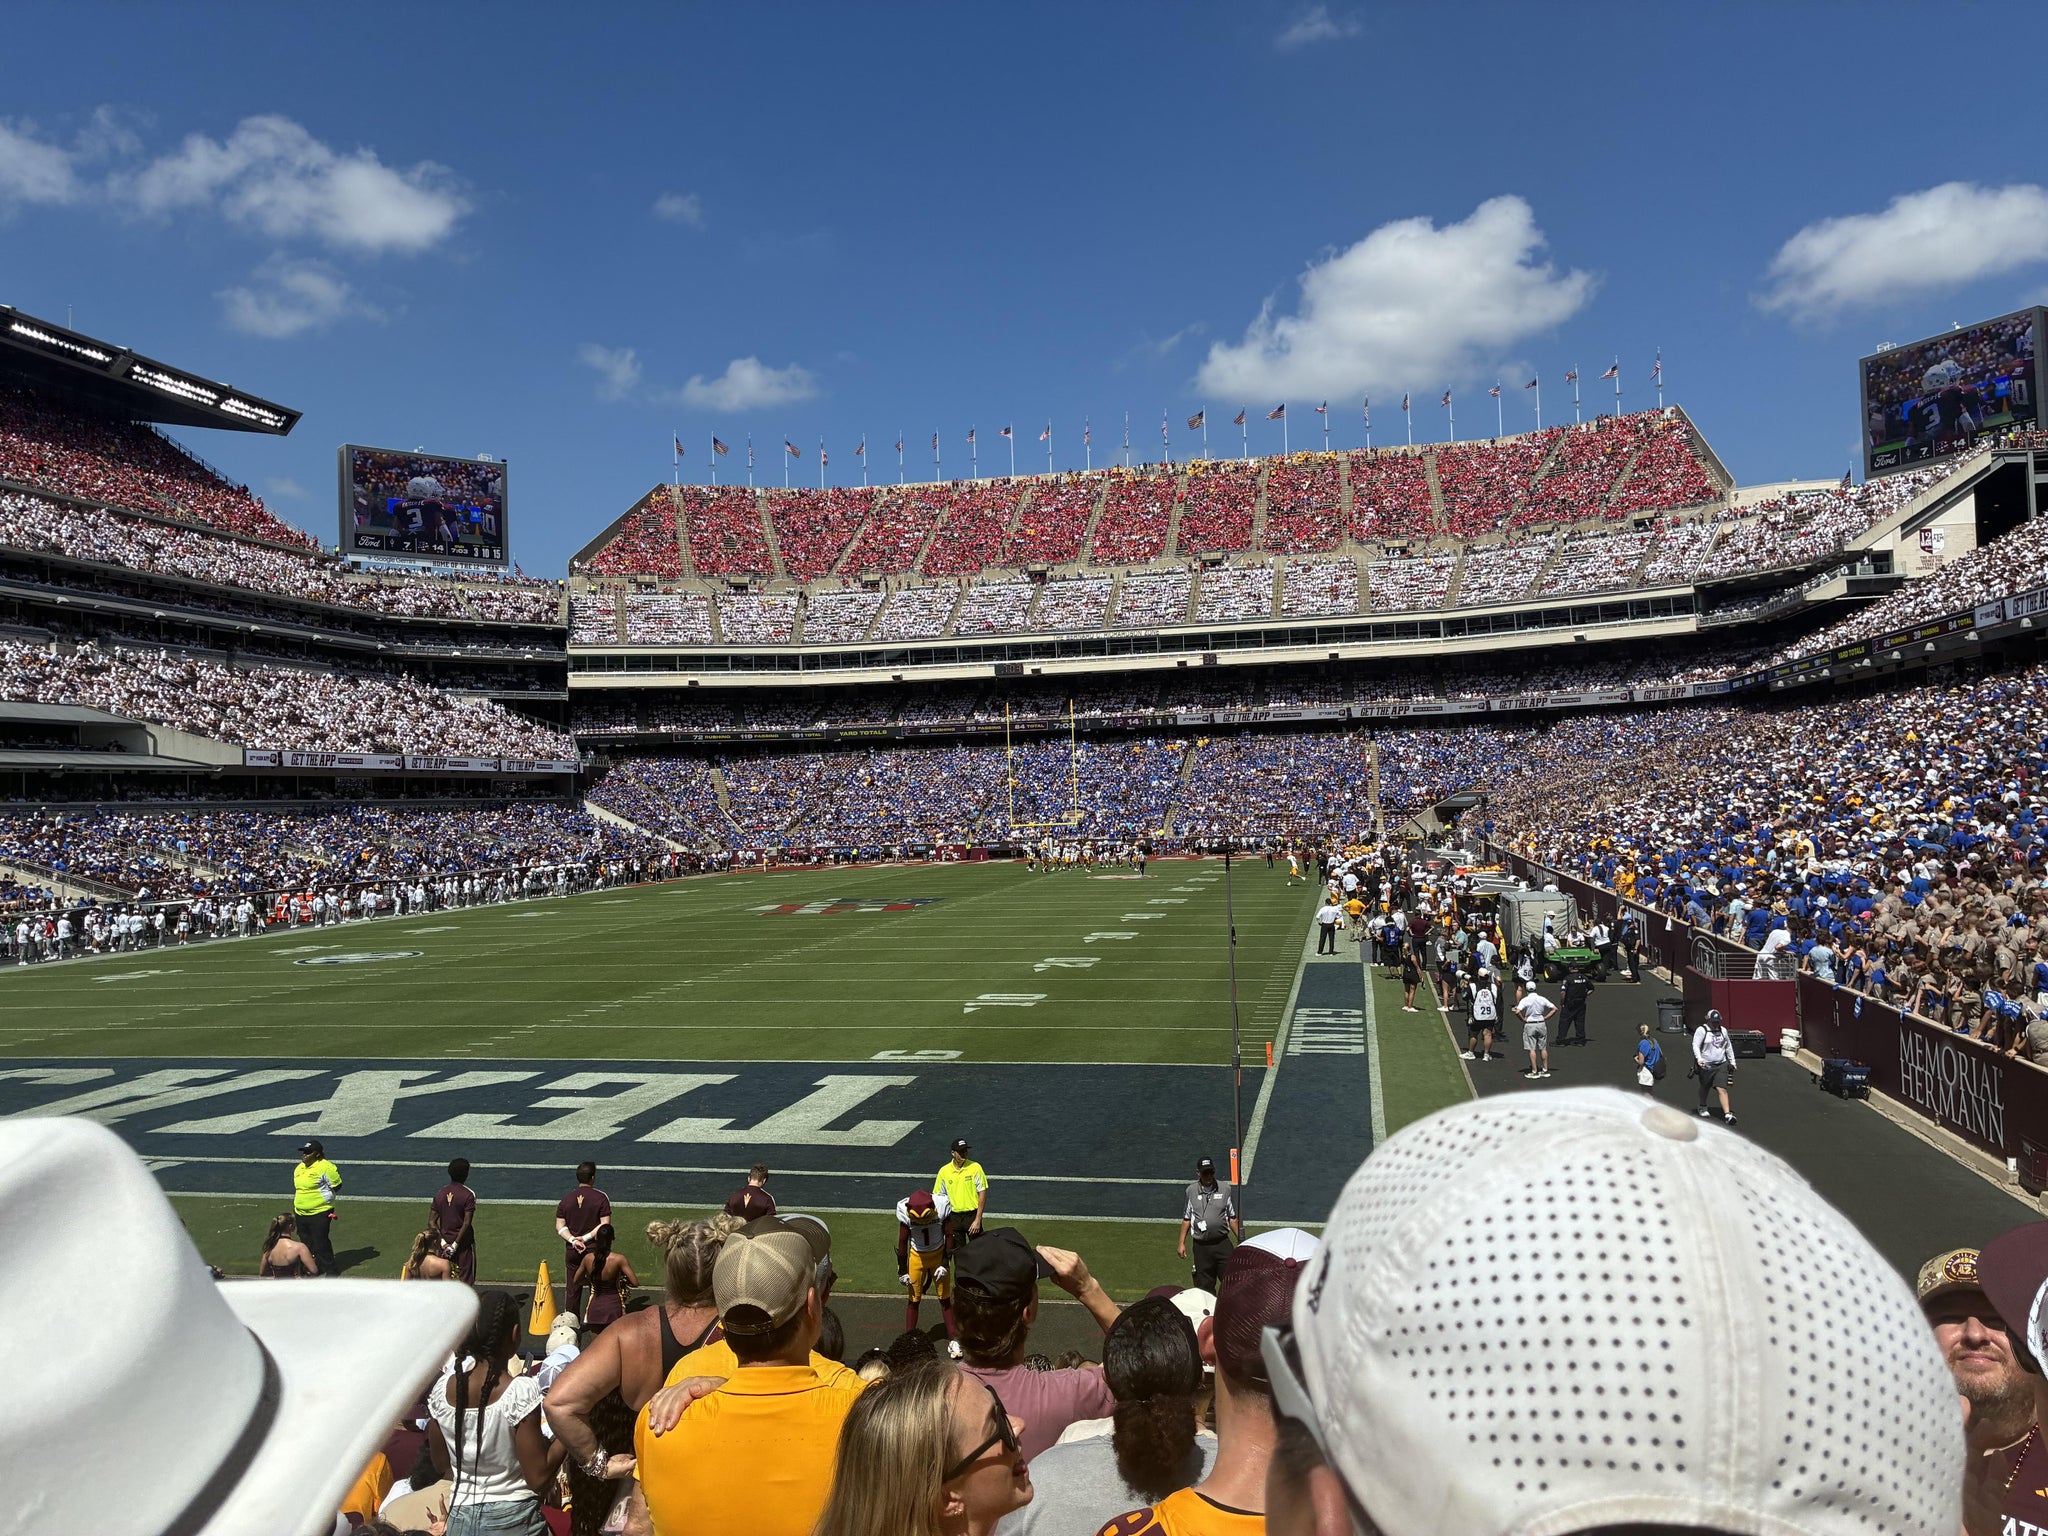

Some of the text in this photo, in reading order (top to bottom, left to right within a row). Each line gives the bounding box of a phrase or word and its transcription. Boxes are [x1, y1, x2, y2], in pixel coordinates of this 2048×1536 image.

[1922, 404, 1940, 430] 3
[1952, 438, 1966, 447] 14
[1874, 454, 1896, 468] Ford
[406, 508, 423, 528] 3
[358, 536, 380, 548] Ford
[1921, 532, 1931, 540] 12
[474, 547, 501, 559] 3 10 15
[2013, 596, 2025, 616] GET
[2026, 592, 2038, 613] THE
[1644, 687, 1686, 700] GET THE APP
[1500, 700, 1513, 709] GET
[1515, 699, 1528, 708] THE
[1529, 698, 1548, 707] APP
[1223, 714, 1236, 722] GET
[1238, 713, 1251, 722] THE
[1252, 712, 1270, 721] APP
[1361, 708, 1374, 716] GET
[1376, 707, 1390, 716] THE
[1391, 706, 1410, 715] APP
[291, 753, 305, 766] GET
[306, 754, 318, 766] THE
[320, 754, 336, 766] APP
[412, 758, 423, 768] GET
[424, 758, 433, 768] THE
[434, 759, 447, 768] APP
[507, 761, 515, 770] GET
[524, 761, 535, 771] APP
[964, 993, 1048, 1007] 10
[1480, 1007, 1492, 1015] 29
[1900, 1025, 2004, 1110] MEMORIAL
[1900, 1058, 2004, 1150] HERMANN
[921, 1228, 930, 1246] 1
